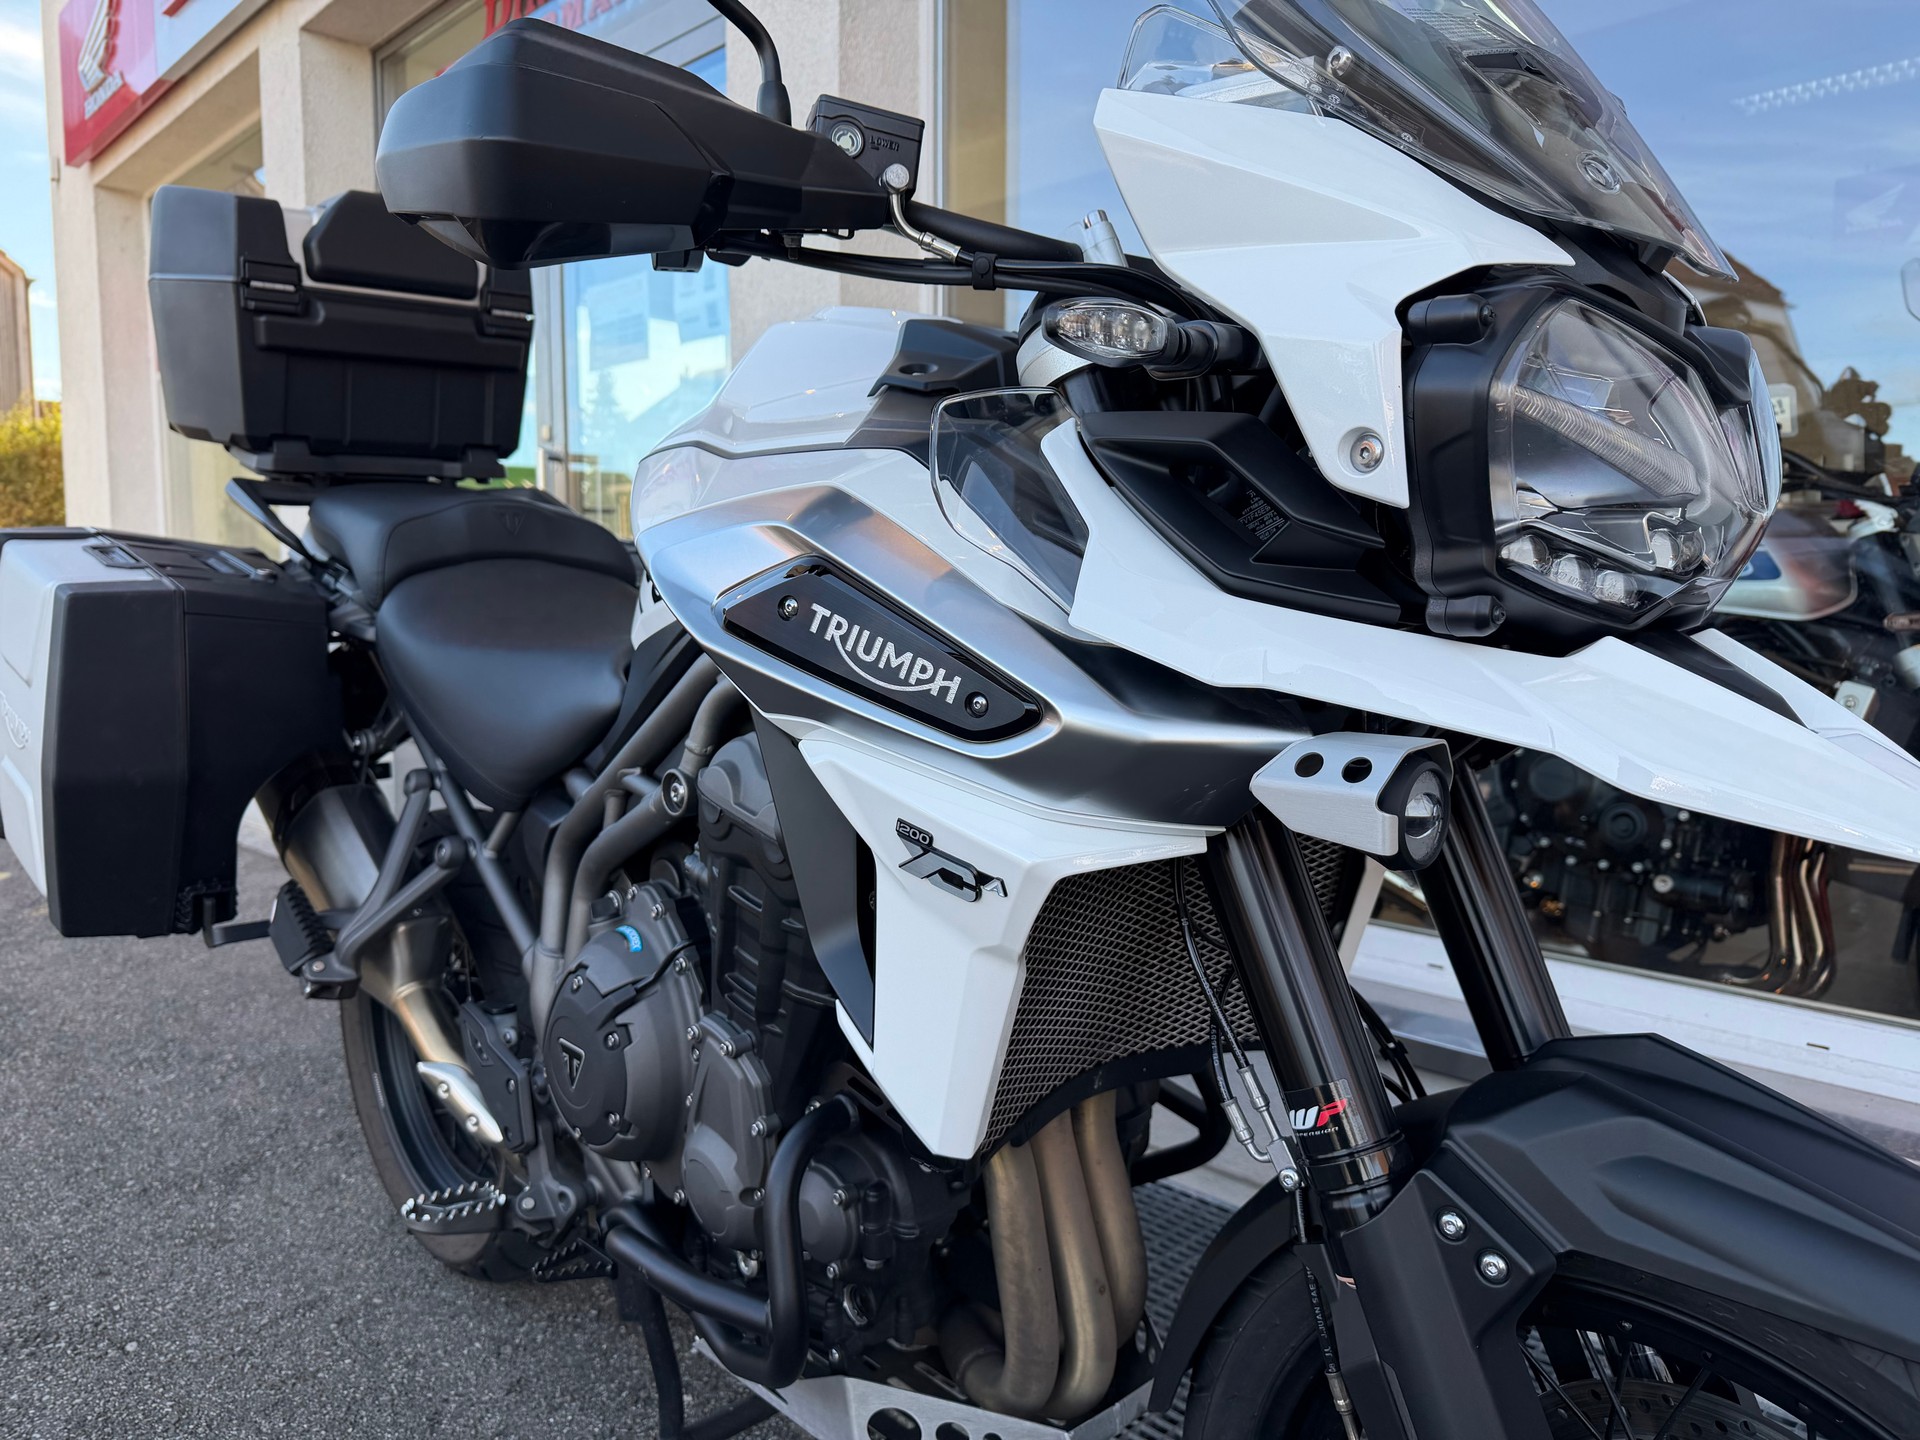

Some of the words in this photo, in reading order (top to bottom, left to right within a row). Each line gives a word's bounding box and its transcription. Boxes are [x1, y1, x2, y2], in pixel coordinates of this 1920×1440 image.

[870, 135, 900, 152] LOWER
[808, 602, 962, 705] TRIUMPH
[896, 821, 931, 845] 1200
[1289, 1098, 1348, 1130] WP
